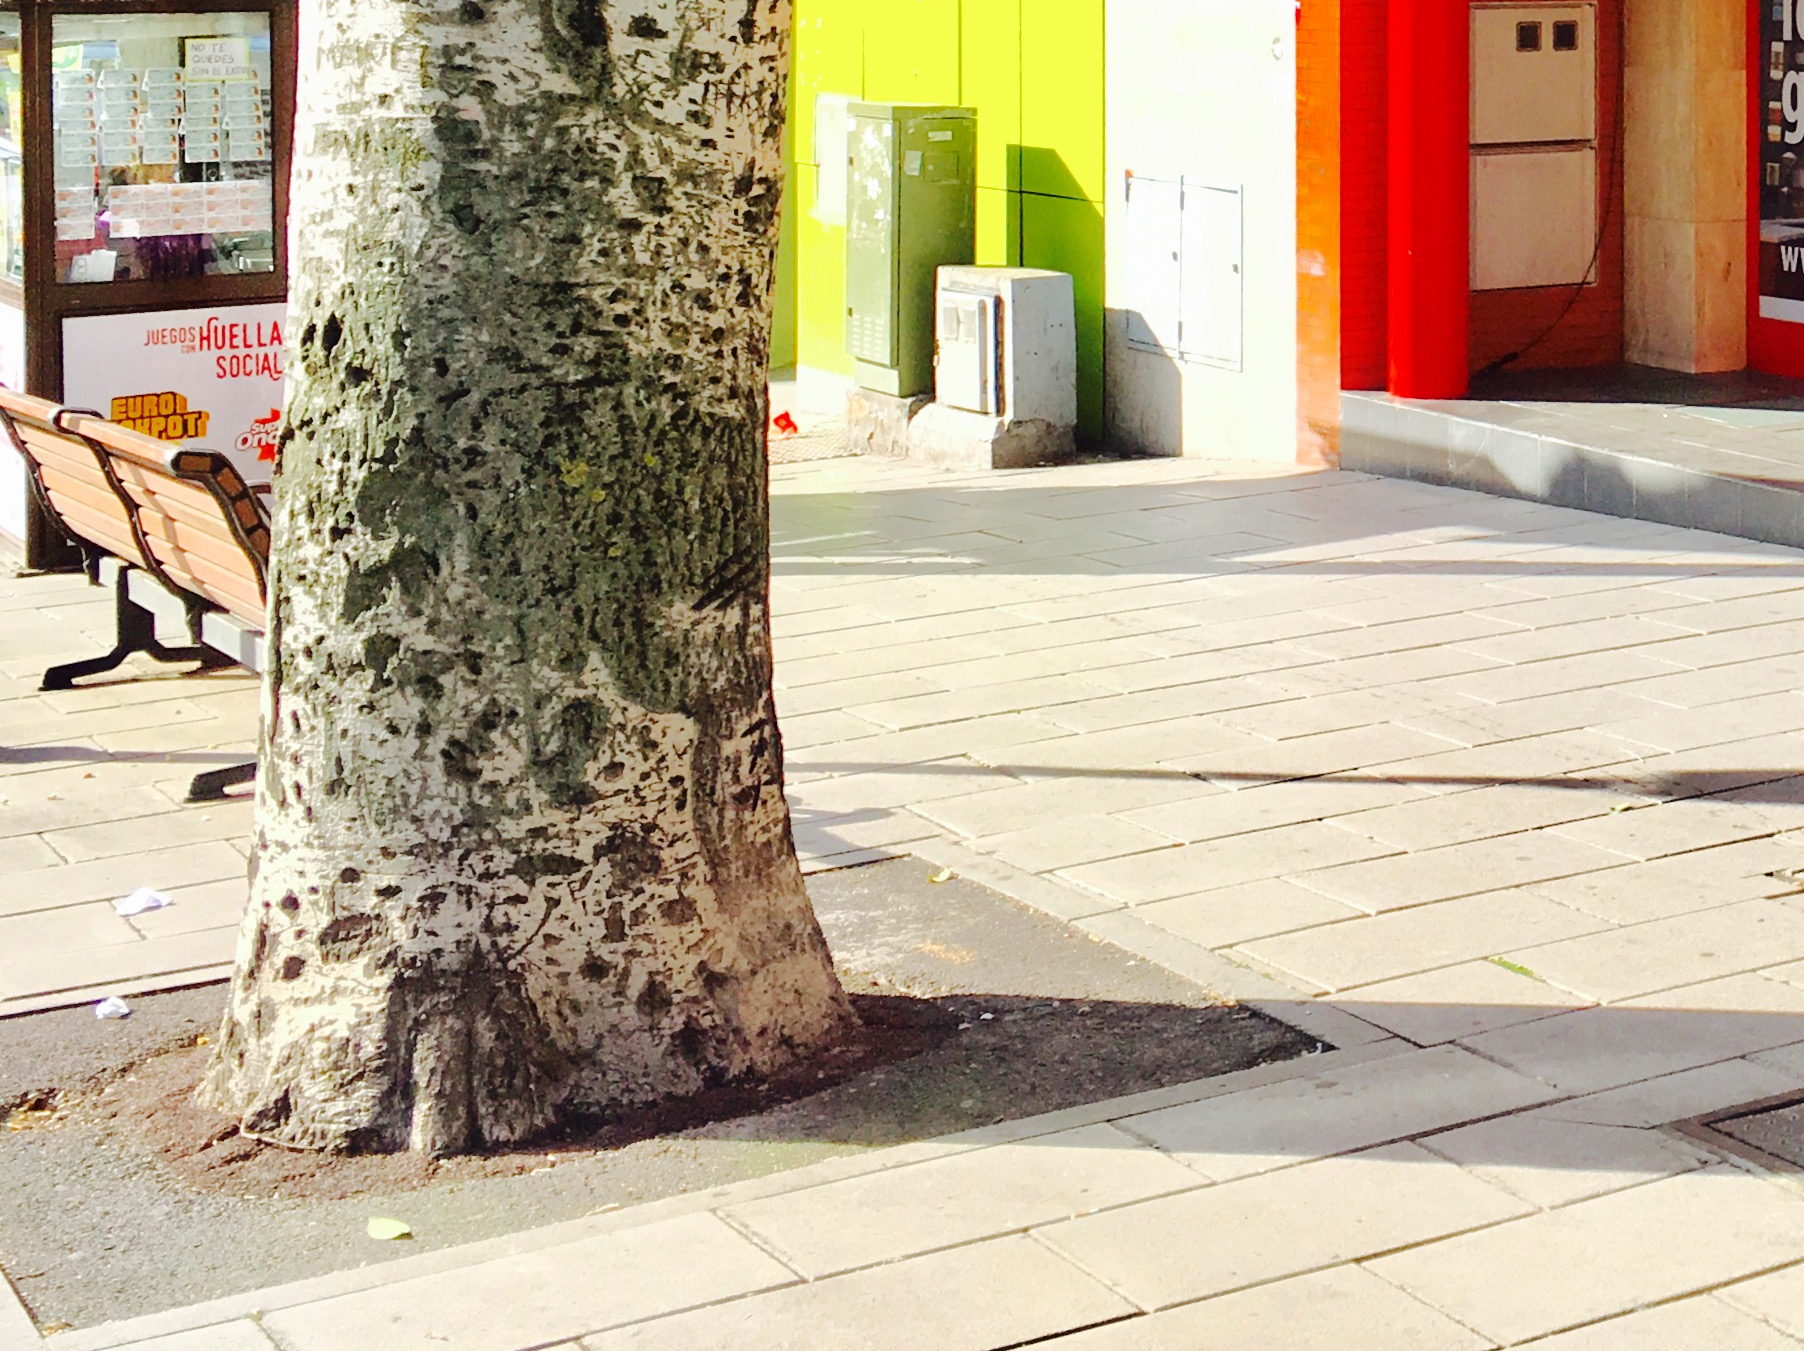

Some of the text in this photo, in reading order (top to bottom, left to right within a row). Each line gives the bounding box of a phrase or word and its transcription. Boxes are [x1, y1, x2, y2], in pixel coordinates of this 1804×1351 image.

[144, 317, 283, 352] JUEGOS HUELLA
[216, 352, 283, 381] SOCIAL
[111, 392, 187, 421] EURO
[235, 431, 279, 451] Onc
